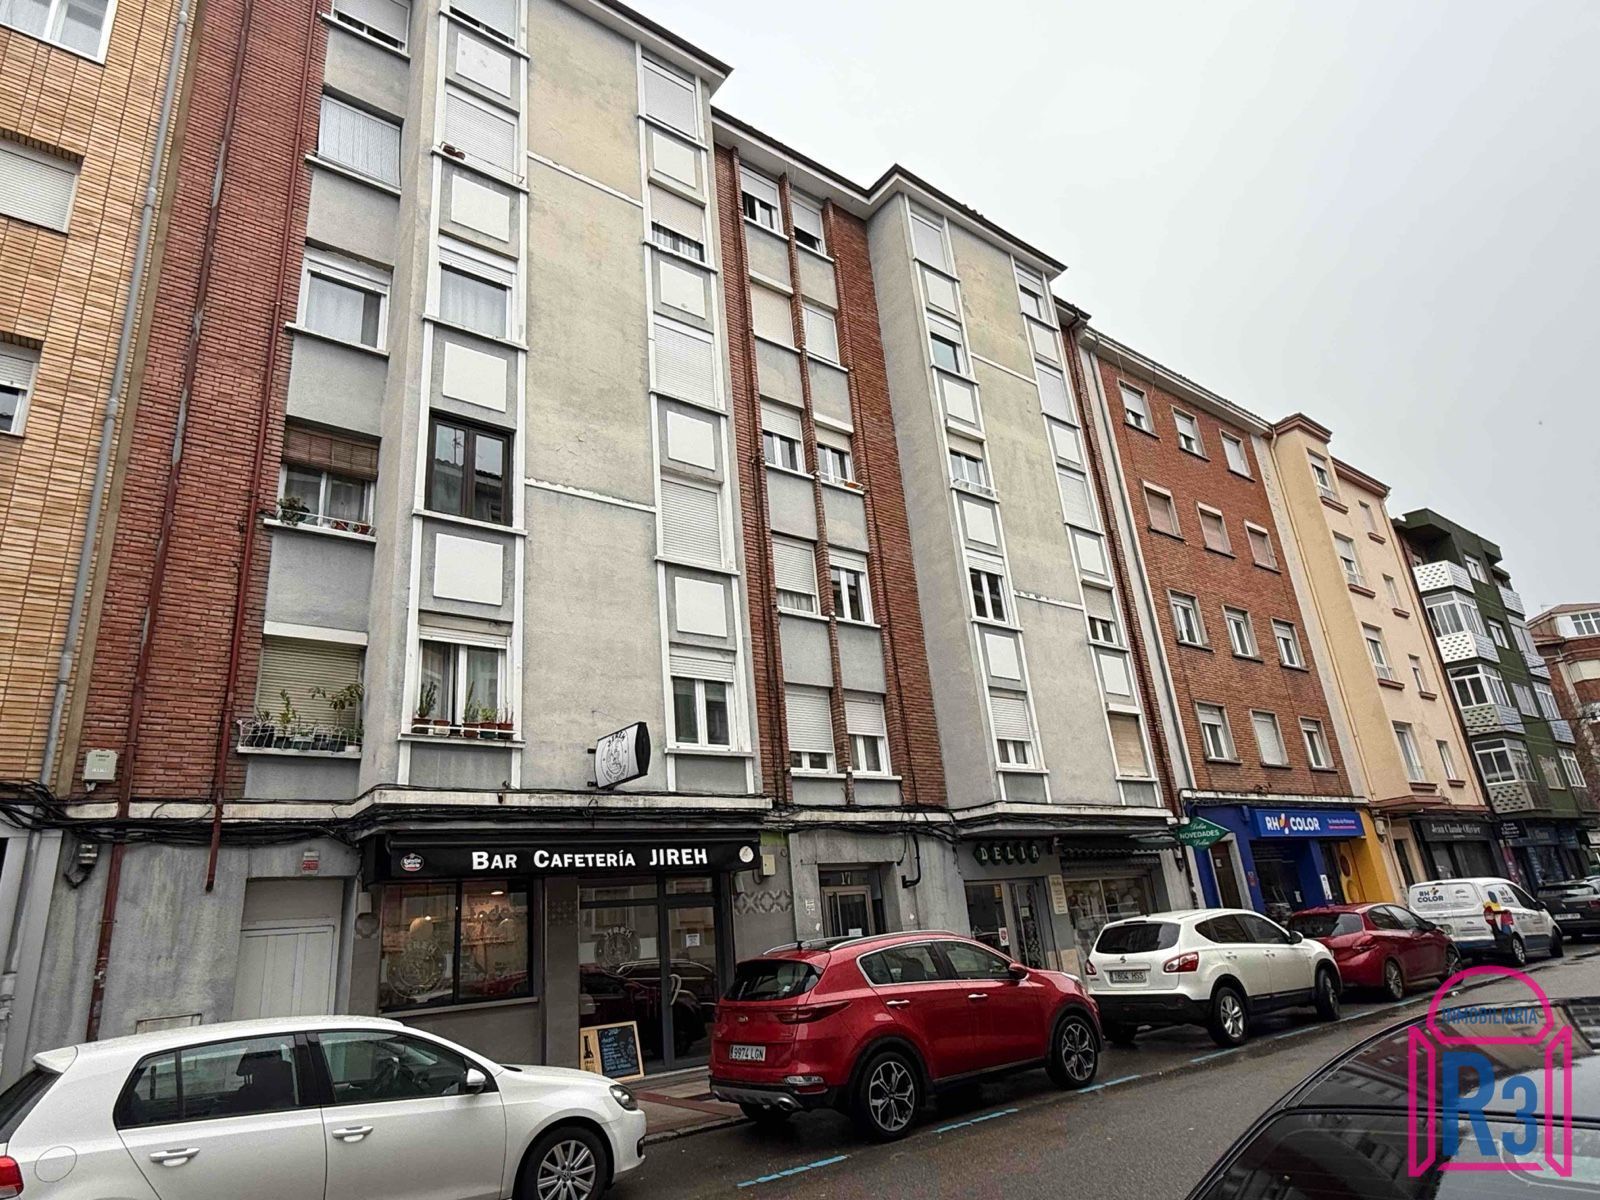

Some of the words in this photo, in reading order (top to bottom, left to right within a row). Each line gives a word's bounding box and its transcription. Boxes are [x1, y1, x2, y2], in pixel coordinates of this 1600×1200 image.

[1265, 816, 1280, 831] RH
[1290, 816, 1320, 831] COLOR
[1179, 829, 1220, 839] NOVEDADES
[472, 851, 518, 870] BAR
[650, 848, 708, 866] JIREH
[980, 845, 1039, 860] DELIA
[841, 871, 852, 885] 17
[1417, 895, 1444, 903] COLOR
